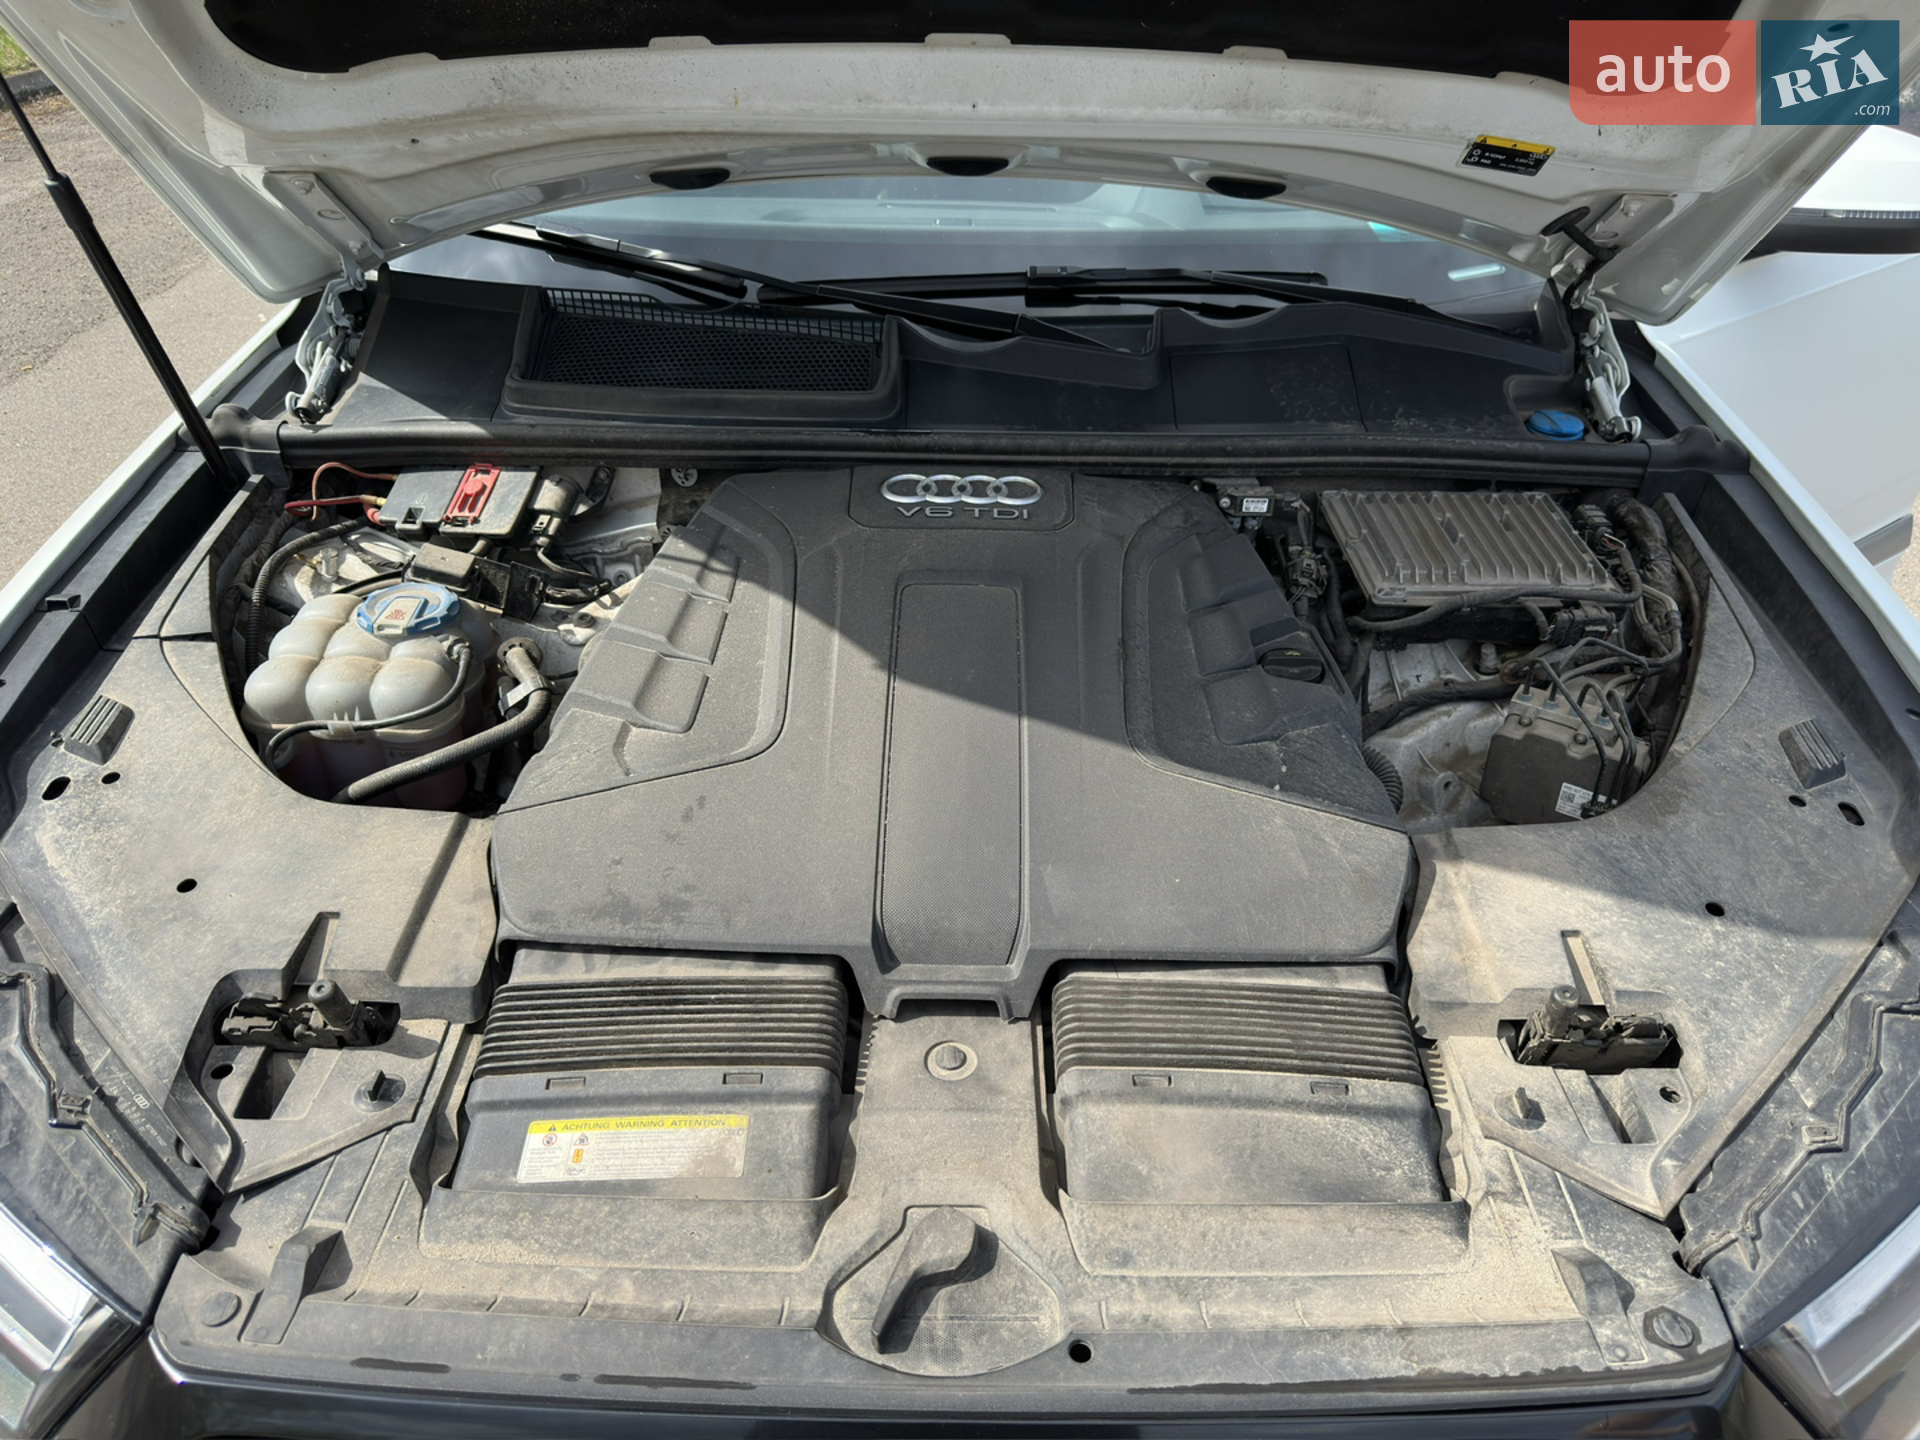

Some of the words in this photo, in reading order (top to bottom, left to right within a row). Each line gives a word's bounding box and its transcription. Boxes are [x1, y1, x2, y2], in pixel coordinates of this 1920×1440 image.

[896, 506, 953, 518] V6
[964, 507, 1028, 519] TDI
[561, 1122, 610, 1131] ACHTUNG
[615, 1120, 665, 1129] WARNING
[670, 1118, 726, 1127] ATTENTION
